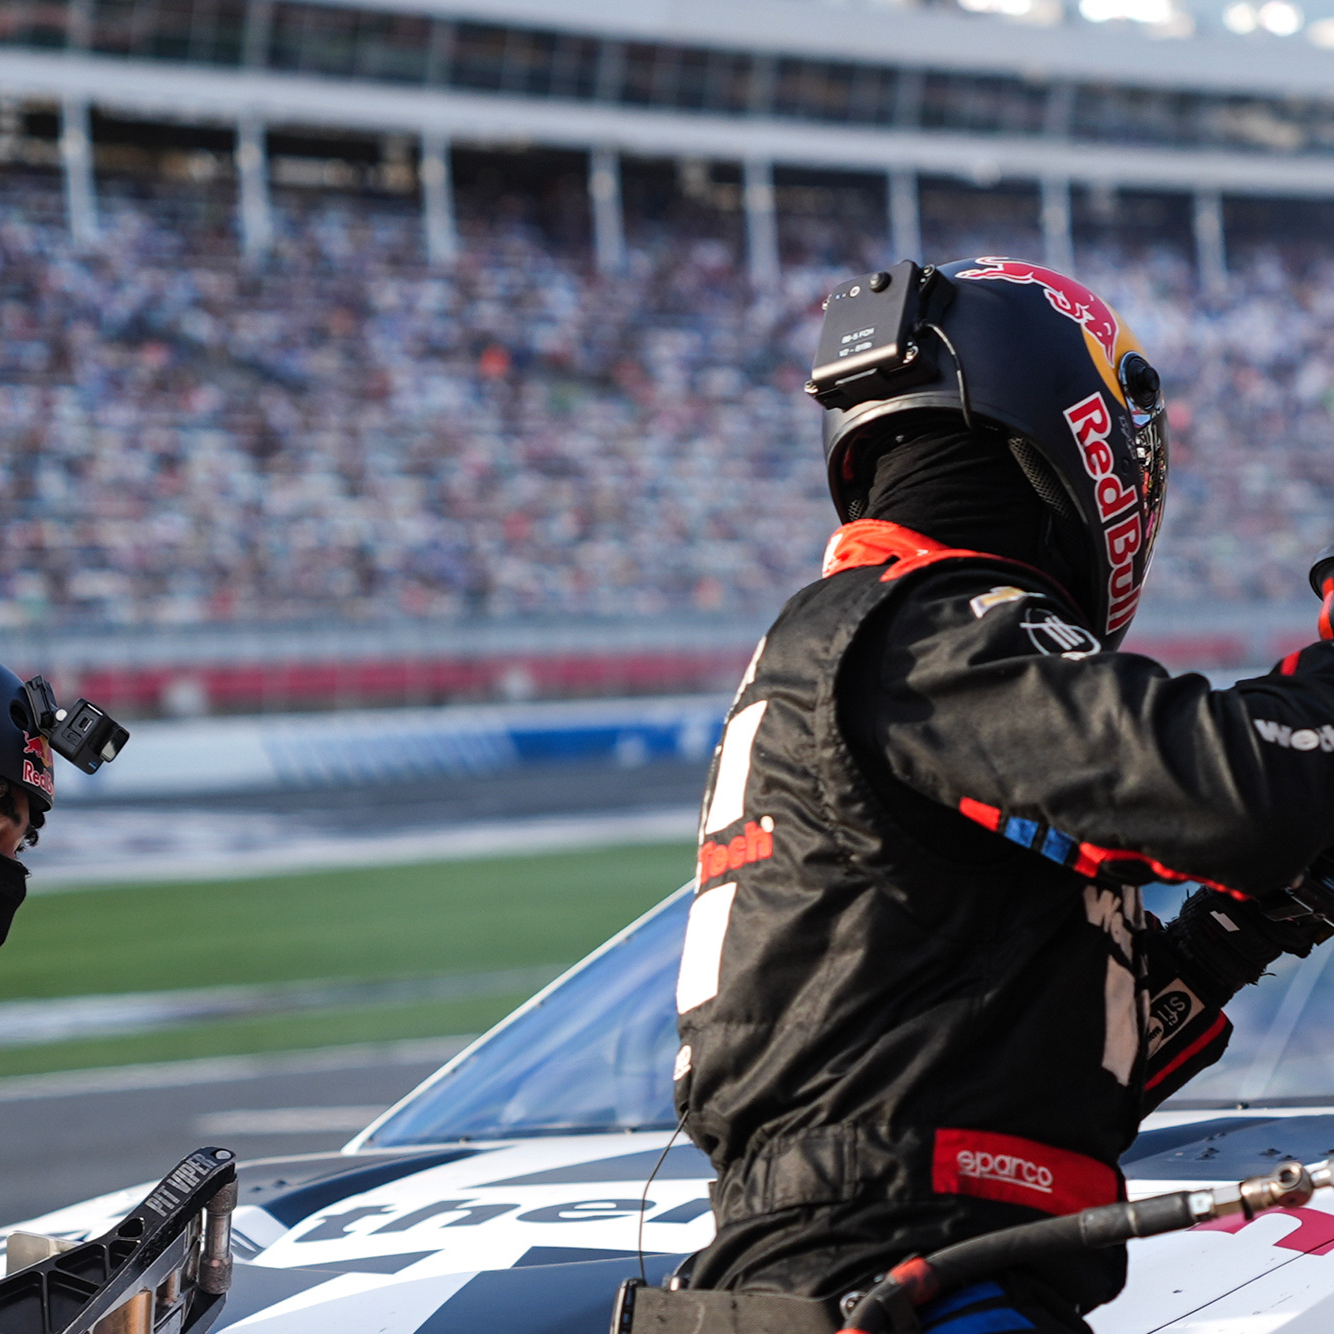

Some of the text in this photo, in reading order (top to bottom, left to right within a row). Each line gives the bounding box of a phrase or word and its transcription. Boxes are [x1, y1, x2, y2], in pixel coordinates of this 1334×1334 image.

[1063, 391, 1142, 636] Red Bull
[144, 1152, 219, 1218] PIT VIPER
[957, 1147, 1054, 1194] sparco
